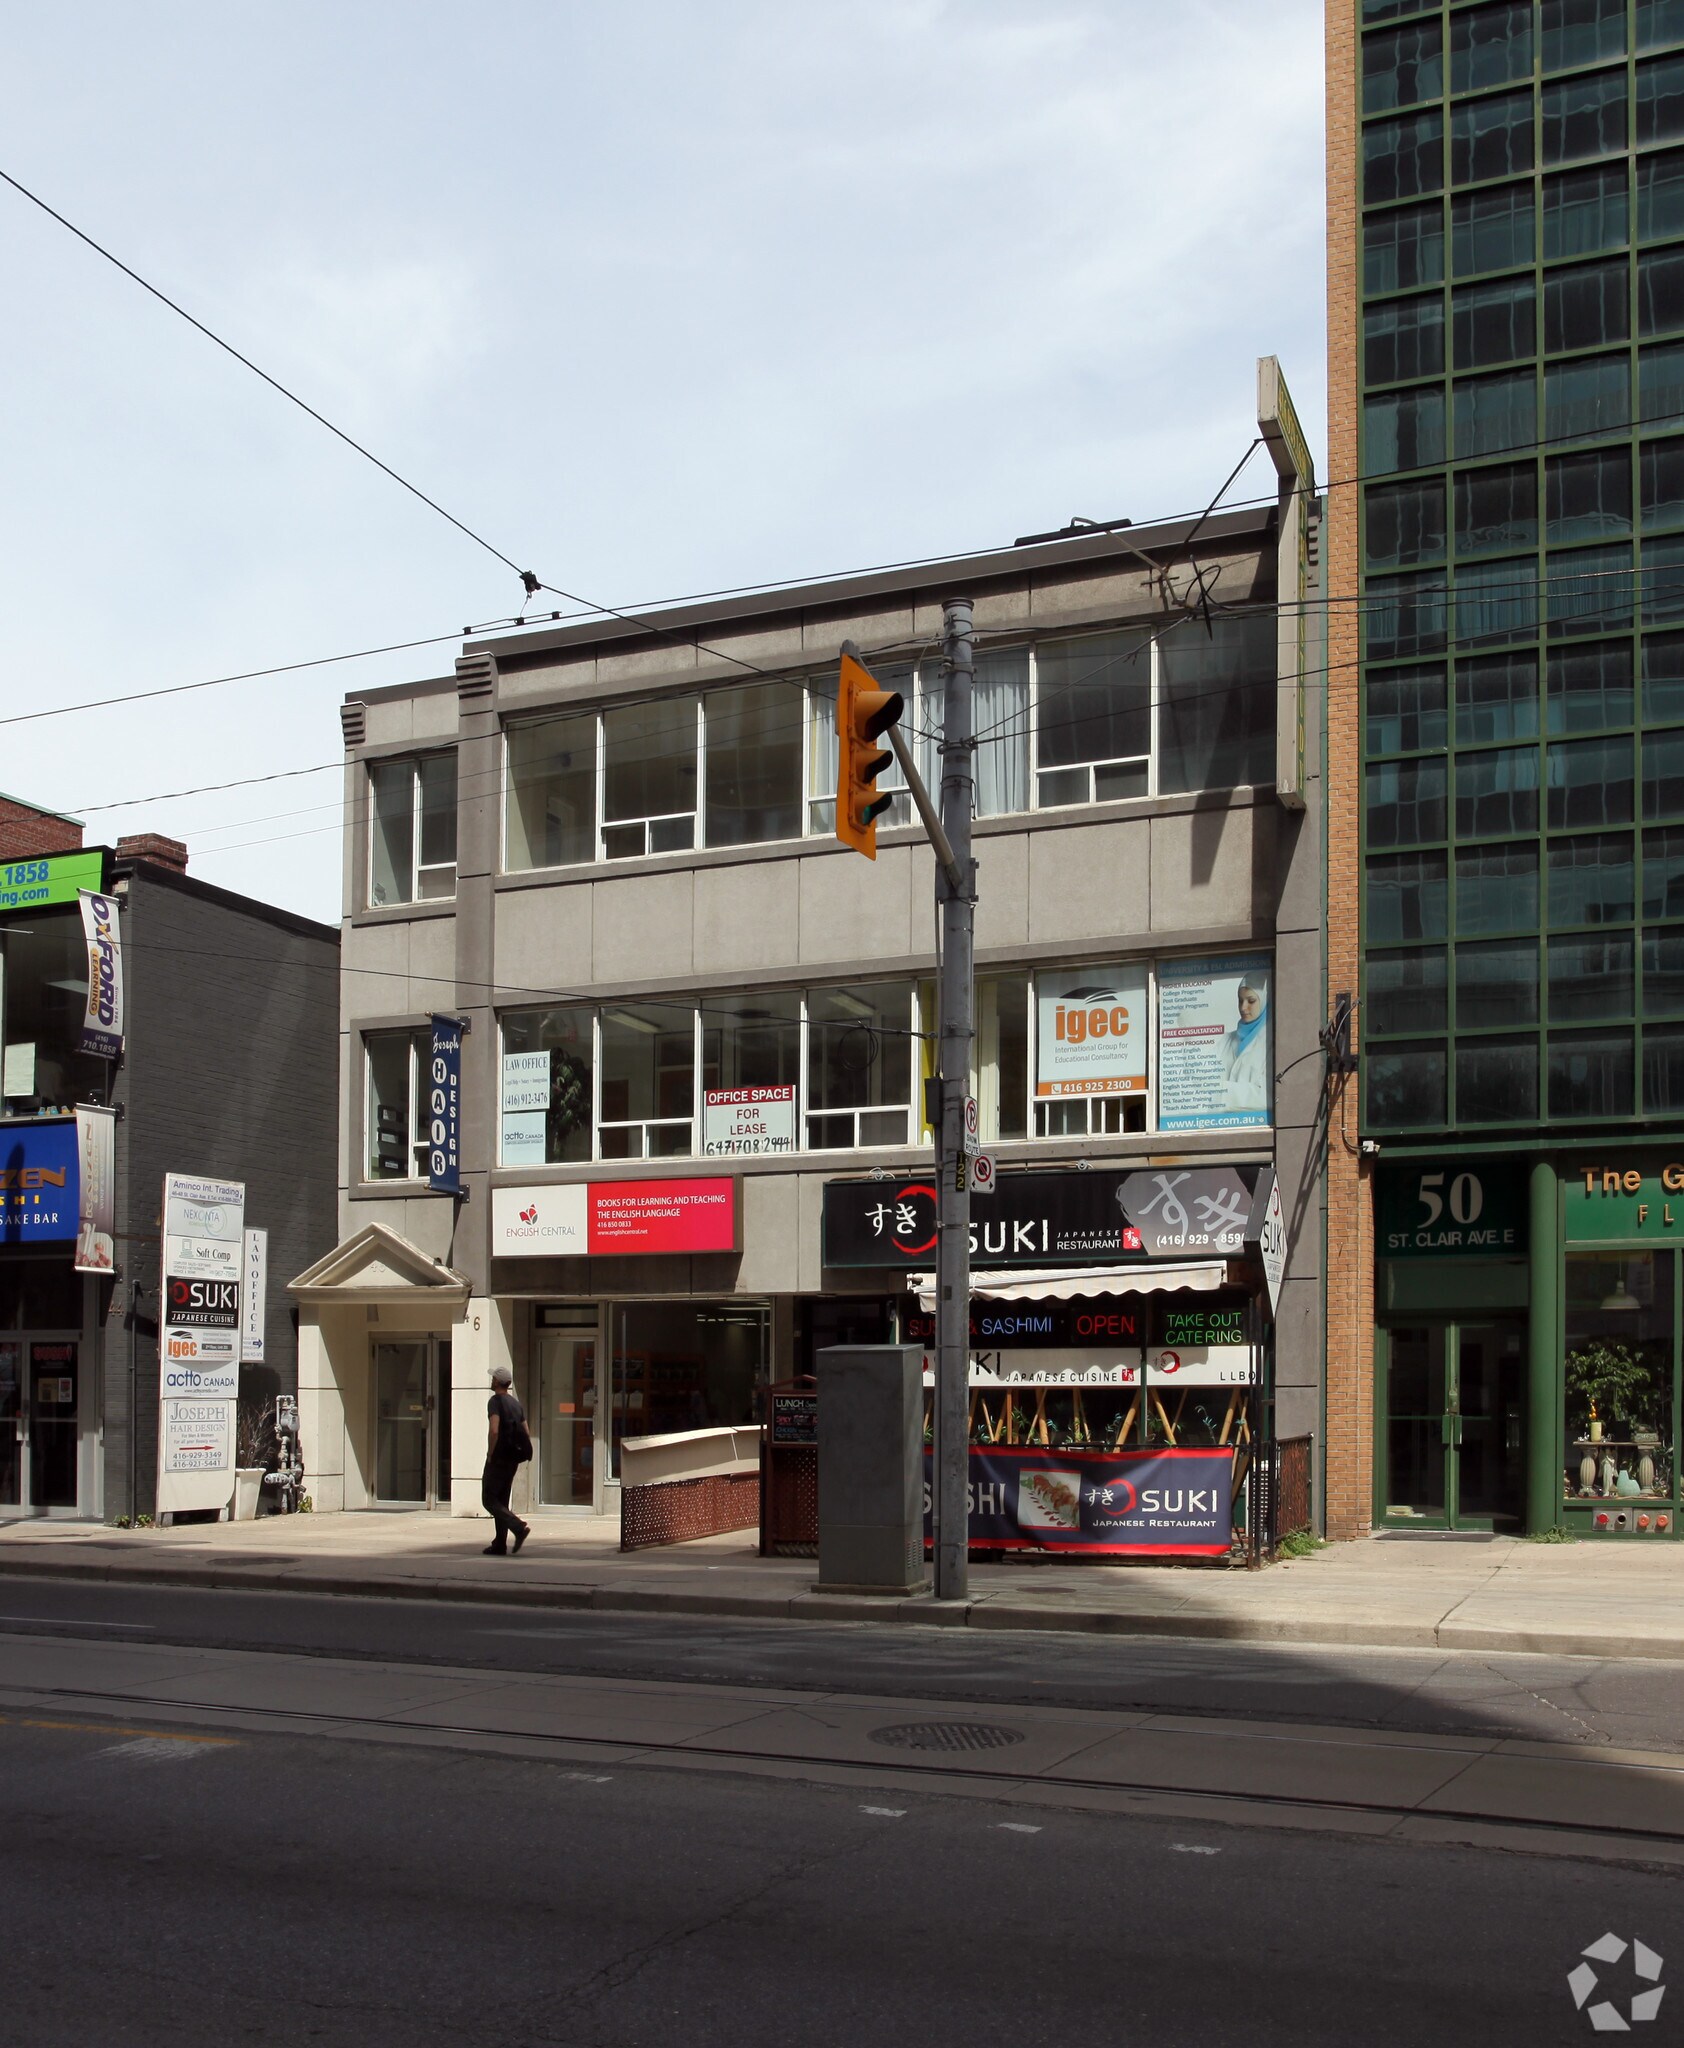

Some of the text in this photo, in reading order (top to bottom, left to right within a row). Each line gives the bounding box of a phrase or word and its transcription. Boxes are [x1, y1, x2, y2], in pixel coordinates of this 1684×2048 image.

[91, 895, 115, 1026] OXFORD
[1160, 964, 1204, 975] UNIVERSITY
[1056, 1005, 1129, 1043] igec
[95, 1034, 108, 1042] (416)
[1178, 1027, 1222, 1036] CONSULTATION!
[83, 1040, 116, 1054] 710.1858
[433, 1032, 459, 1054] Joseph
[1055, 1044, 1097, 1053] International
[1097, 1043, 1117, 1052] Group
[505, 1057, 547, 1071] LAW OFFICE
[1055, 1053, 1128, 1063] Educational Consultancy
[1064, 1080, 1132, 1093] 416 925 2300
[505, 1092, 547, 1108] (416) 912-3476
[709, 1088, 789, 1103] OFFICE SPACE
[737, 1109, 760, 1119] FOR
[1167, 1116, 1255, 1128] www.igec.com.au
[505, 1132, 524, 1140] actto
[730, 1124, 767, 1135] LEASE
[966, 1144, 979, 1154] ROUTE
[1580, 1166, 1641, 1191] The
[174, 1180, 200, 1191] Aminco
[215, 1186, 239, 1197] Trading
[597, 1195, 726, 1207] BOOKS FOR LEARNING AND TEACHING
[1417, 1172, 1483, 1229] 50
[34, 1212, 58, 1224] BAR
[184, 1209, 219, 1222] NEXONTA
[597, 1208, 680, 1219] THE ENGLISH LANGUAGE
[864, 1203, 917, 1236] すき
[506, 1226, 575, 1237] ENGLISH CENTRAL
[1057, 1229, 1119, 1238] JAPANESE
[1388, 1229, 1514, 1248] ST. CLAIR AVE. E
[1057, 1239, 1121, 1250] RESTAURANT
[1156, 1234, 1185, 1248] (416)
[1189, 1234, 1209, 1244] 929
[196, 1247, 230, 1262] Soft Comp
[190, 1283, 237, 1309] SUKI
[251, 1271, 259, 1332] OFFICE
[172, 1314, 208, 1322] JAPANESE
[1076, 1315, 1134, 1335] OPEN
[1167, 1312, 1242, 1327] TAKE OUT
[982, 1317, 1052, 1335] SASHIMI
[1166, 1330, 1242, 1344] CATERING
[168, 1339, 197, 1358] igec
[167, 1370, 234, 1386] actto CANADA
[1006, 1373, 1117, 1382] JAPANESE CUISINE
[776, 1399, 804, 1408] LUNCH
[170, 1403, 225, 1420] JOSEPH
[196, 1424, 225, 1432] DESIGN
[173, 1460, 220, 1468] 416-921-5441
[1085, 1488, 1114, 1506] すき
[1141, 1490, 1217, 1512] SUKI
